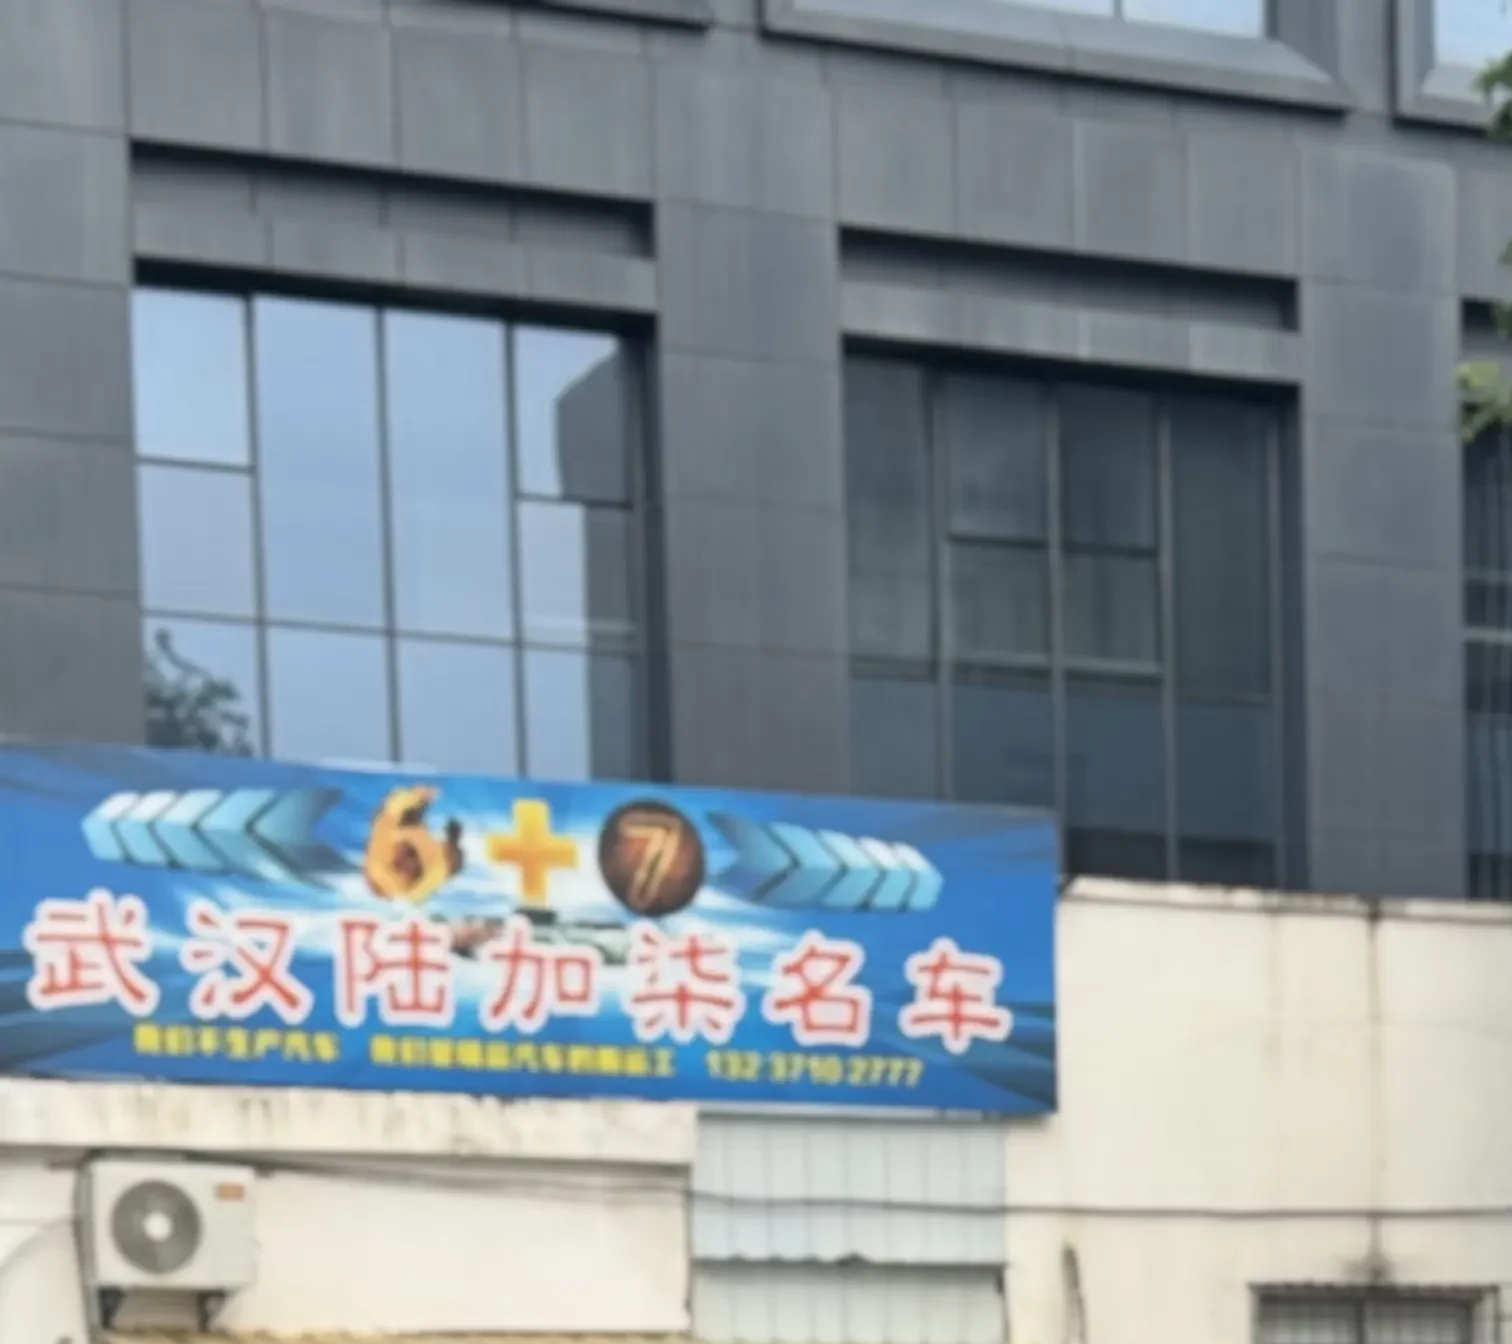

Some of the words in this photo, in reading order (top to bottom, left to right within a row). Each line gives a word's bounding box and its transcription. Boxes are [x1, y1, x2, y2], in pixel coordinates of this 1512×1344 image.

[25, 889, 1012, 1053] 武汉陆加柒名车
